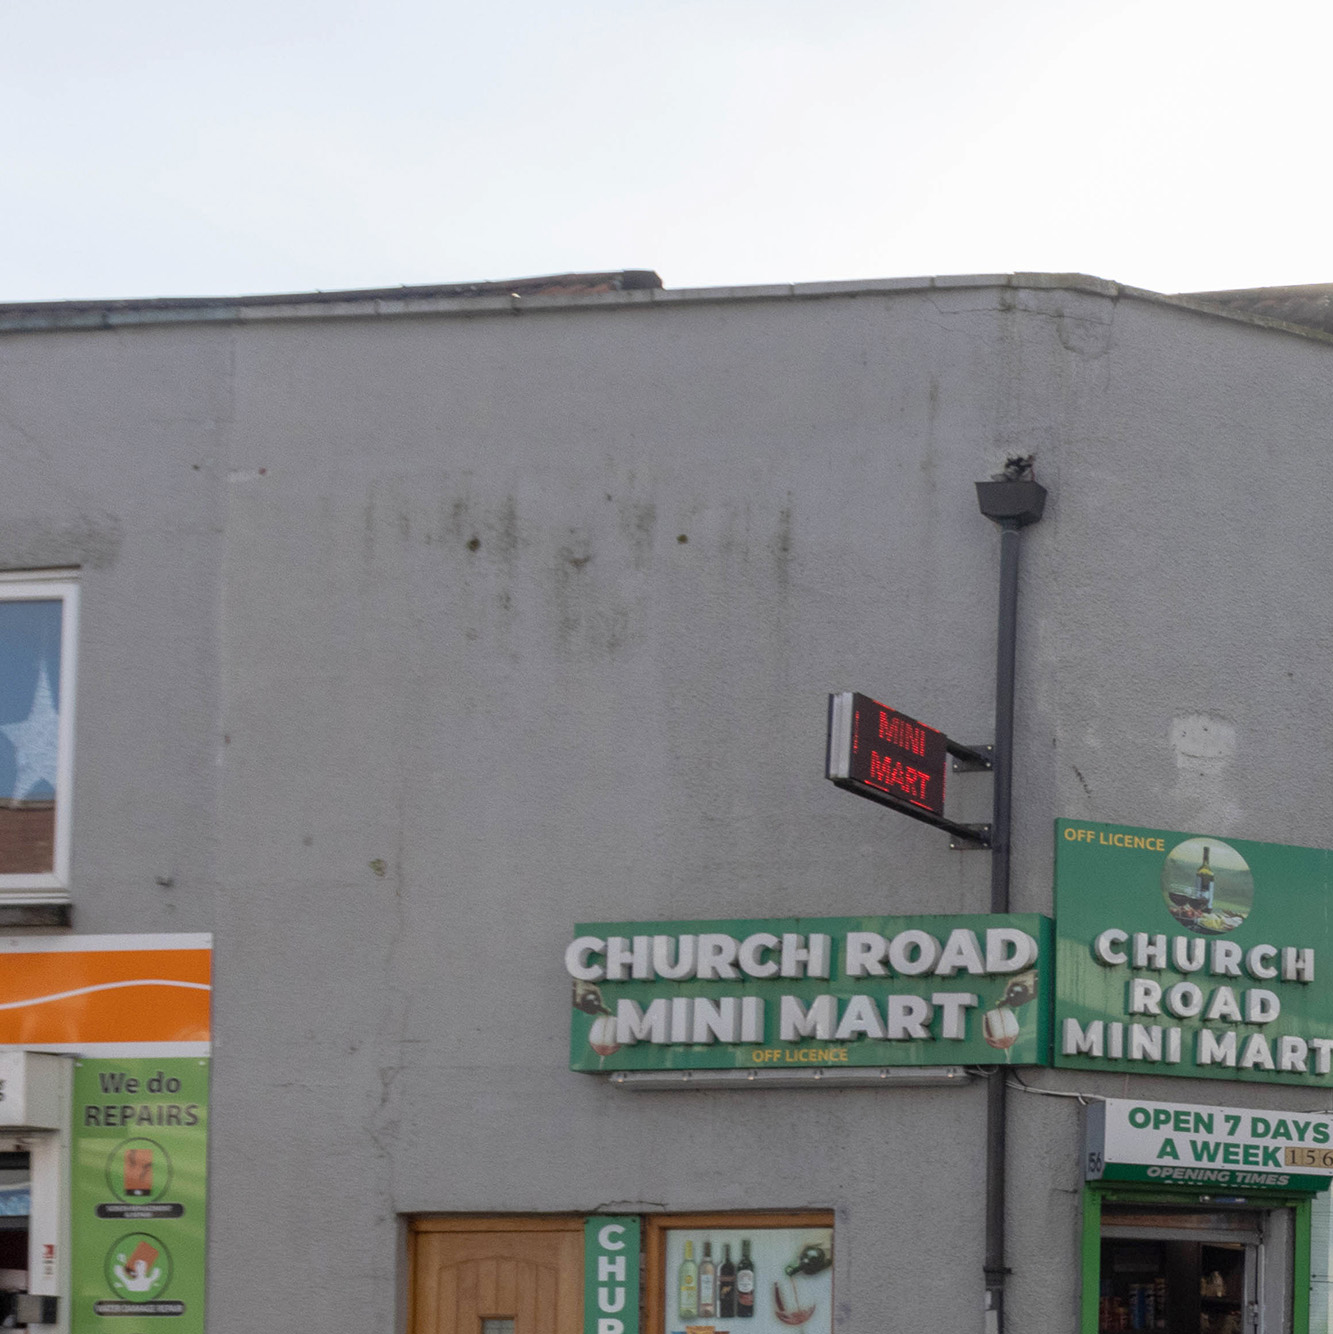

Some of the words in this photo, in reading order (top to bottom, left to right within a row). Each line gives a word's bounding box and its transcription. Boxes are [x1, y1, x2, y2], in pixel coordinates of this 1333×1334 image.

[878, 711, 925, 757] MINI
[870, 750, 930, 799] MART
[1064, 827, 1096, 843] OFF
[1099, 831, 1165, 851] LICENCE
[564, 932, 830, 981] CHURCH
[845, 928, 1039, 978] ROAD
[1095, 928, 1315, 982] CHURCH
[616, 995, 764, 1046] MINI
[780, 992, 978, 1042] MART
[1128, 978, 1281, 1024] ROAD
[752, 1049, 782, 1063] OFF
[784, 1048, 848, 1062] LICENCE
[1062, 1018, 1181, 1064] MINI
[98, 1072, 139, 1094] We
[147, 1070, 182, 1094] do
[84, 1104, 199, 1127] REPAIRS
[1128, 1107, 1214, 1135] OPEN
[1224, 1114, 1242, 1136] 7
[1250, 1116, 1331, 1144] DAYS
[1156, 1138, 1180, 1160] A
[1191, 1140, 1283, 1167] WEEK
[1147, 1167, 1231, 1182] OPENING
[1235, 1171, 1290, 1185] TIMES
